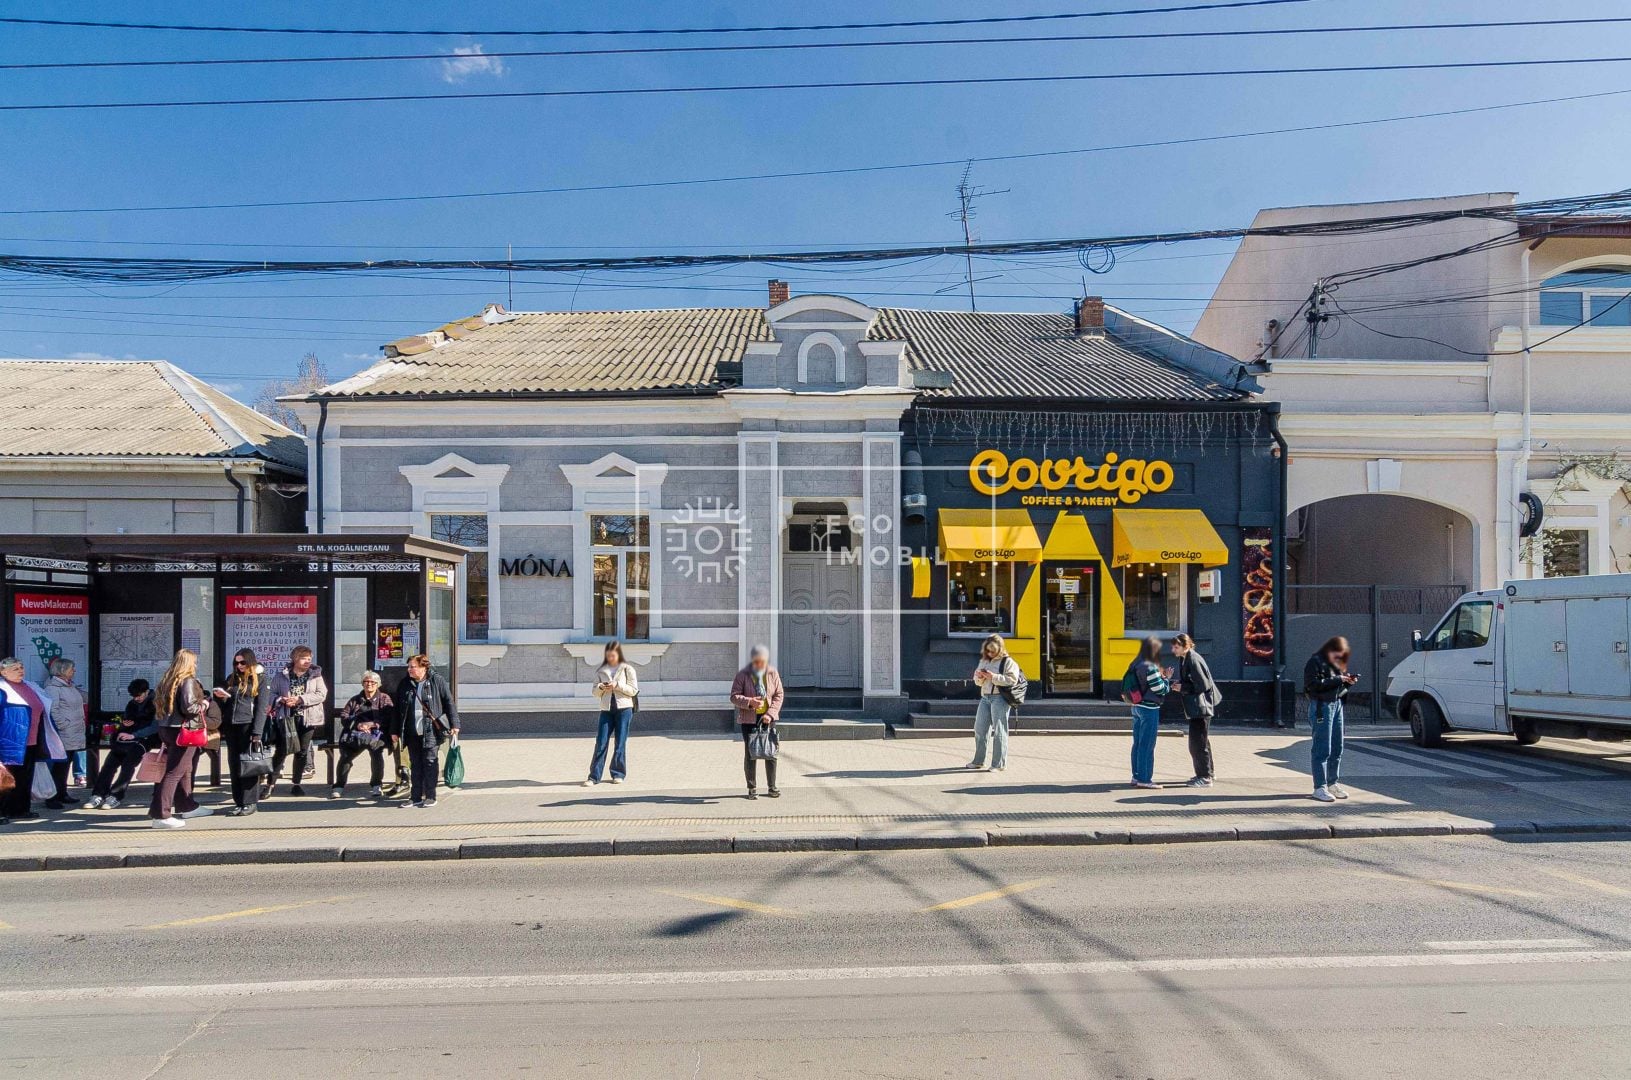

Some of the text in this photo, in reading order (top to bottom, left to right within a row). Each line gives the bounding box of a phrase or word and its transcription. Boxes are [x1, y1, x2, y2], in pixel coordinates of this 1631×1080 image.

[969, 449, 1174, 504] Covrigo
[1021, 495, 1062, 505] COFFEE
[1065, 495, 1073, 506] &
[297, 544, 316, 552] STR.
[327, 543, 390, 552] KOGĂLNICEANU
[974, 548, 1016, 559] Covrigo
[1160, 549, 1202, 561] Covrigo
[21, 598, 83, 609] NewsMaker.md
[234, 599, 309, 609] NewsMaker.md
[20, 616, 43, 626] Spune
[53, 616, 84, 625] contează
